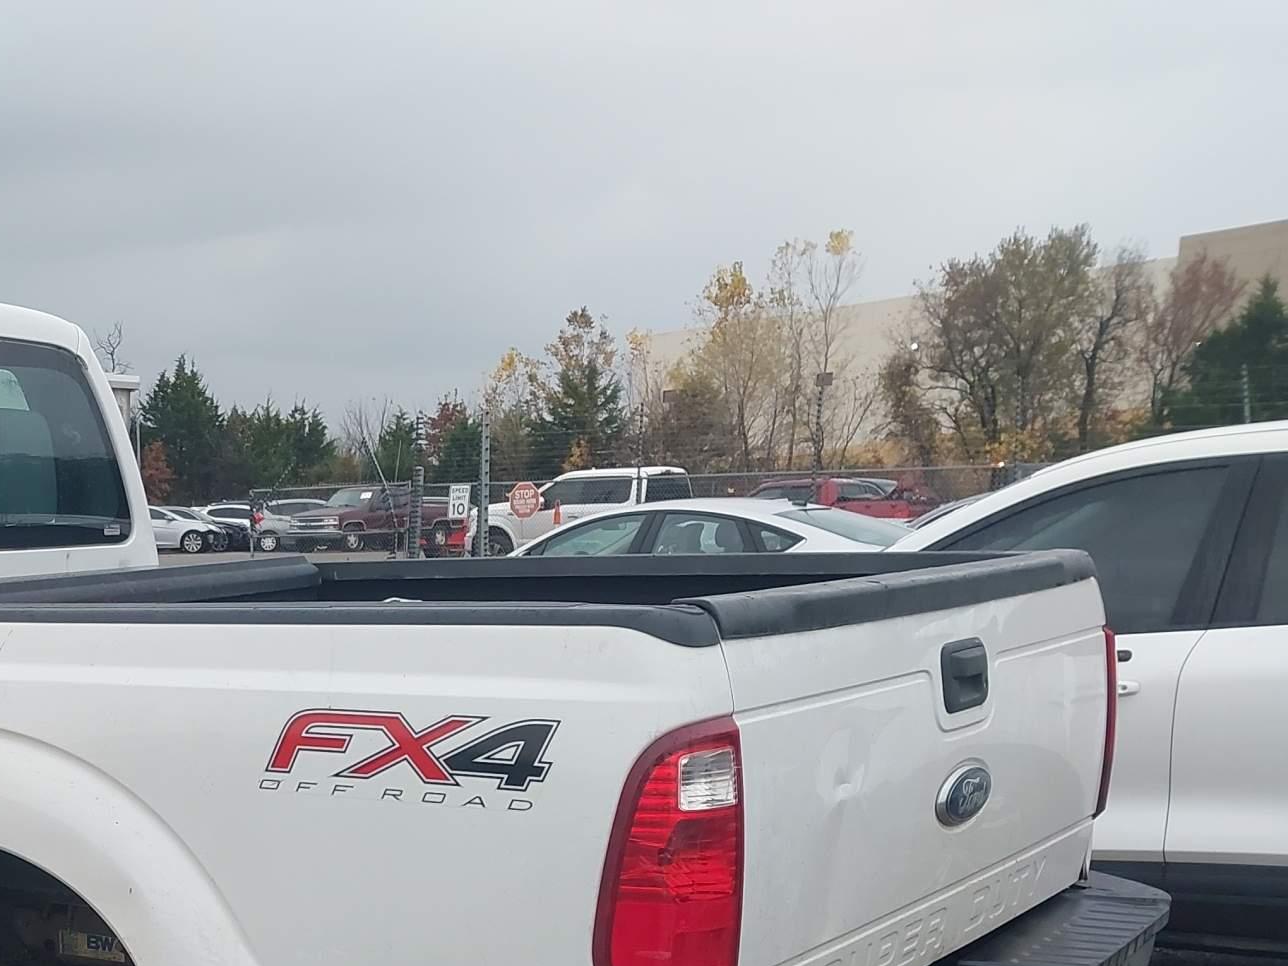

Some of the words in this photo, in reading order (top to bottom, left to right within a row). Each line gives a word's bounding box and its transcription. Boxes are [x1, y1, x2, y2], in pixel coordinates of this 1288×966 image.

[452, 502, 465, 516] 10
[514, 489, 535, 499] STOP
[265, 707, 561, 792] FX4
[259, 779, 354, 796] OFF
[381, 788, 534, 811] ROAD
[963, 856, 1047, 933] DUTY
